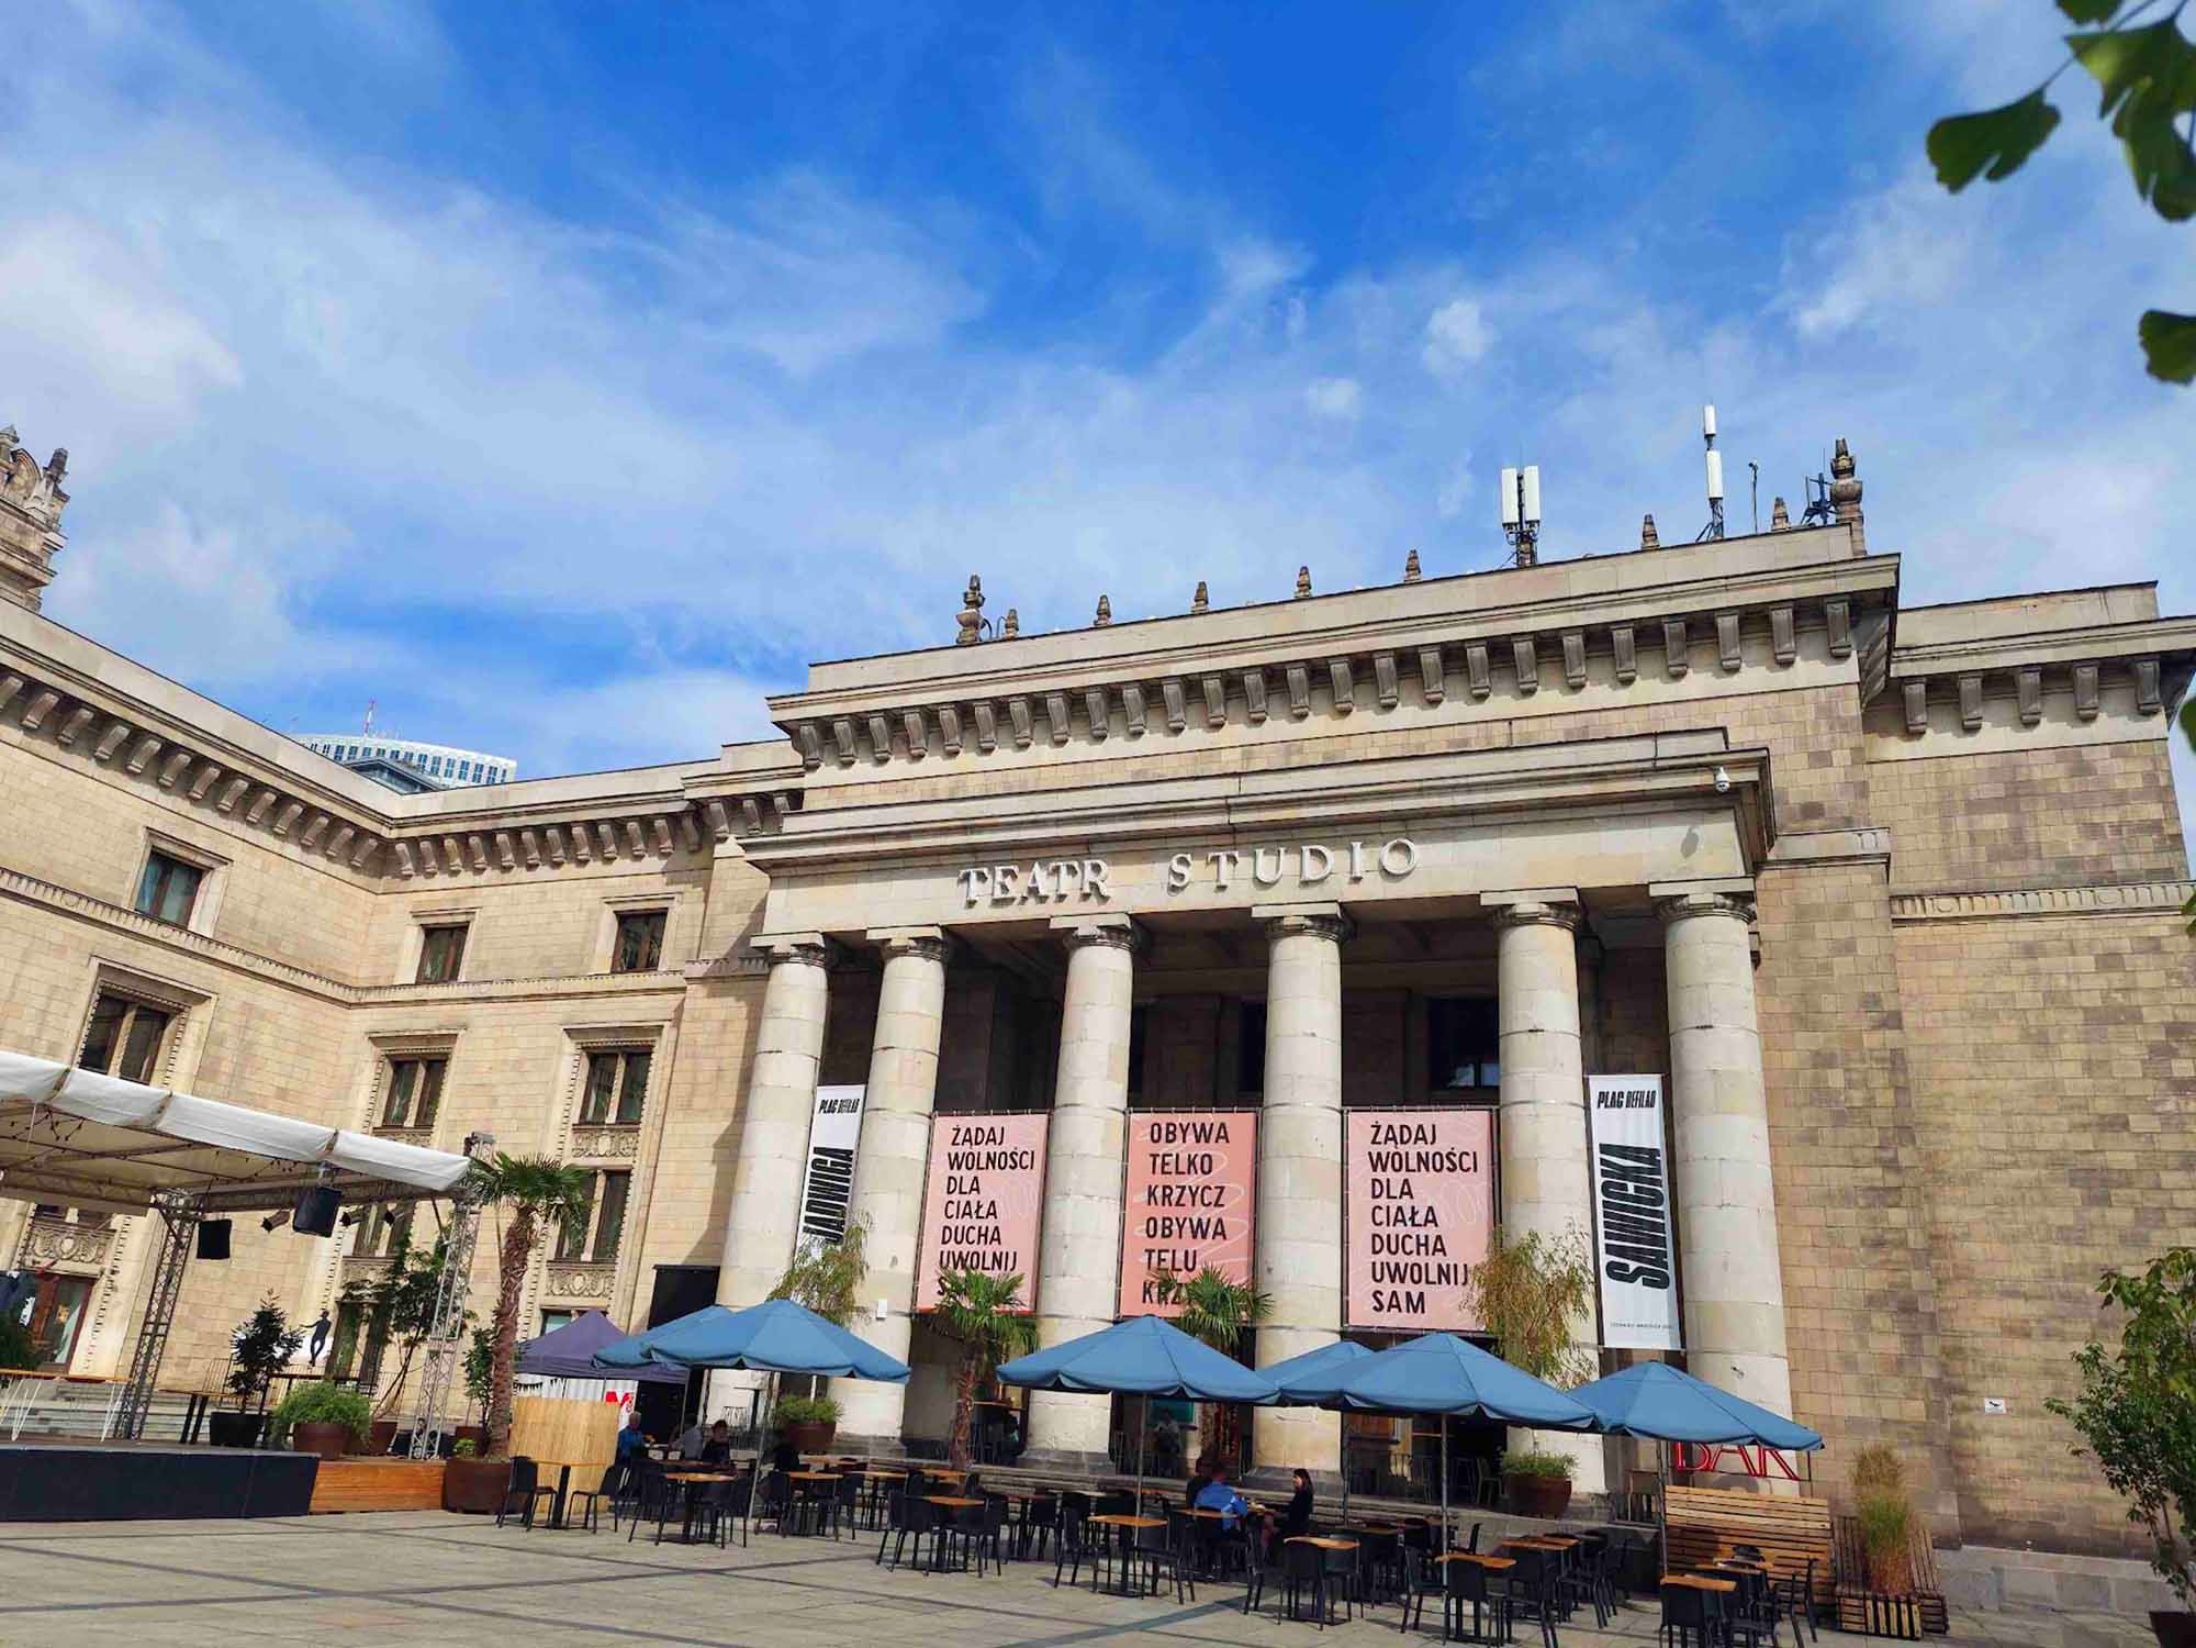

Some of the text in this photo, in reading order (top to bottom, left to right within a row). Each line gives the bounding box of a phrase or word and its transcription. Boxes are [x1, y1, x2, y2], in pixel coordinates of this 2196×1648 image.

[959, 838, 1418, 907] TEATR STUDIO
[818, 1099, 838, 1114] PLAC
[1597, 1090, 1657, 1109] PLAC DEFILAD
[951, 1125, 1005, 1149] ŻĄDAJ
[1150, 1122, 1230, 1144] OBYWA
[1370, 1121, 1437, 1149] ŻĄDAJ
[947, 1147, 1035, 1171] WOLNOŚCI
[1149, 1153, 1213, 1175] TELKO
[1368, 1147, 1478, 1173] WOLNOŚCI
[802, 1146, 854, 1246] JADWIGA
[946, 1175, 981, 1195] DLA
[1147, 1184, 1226, 1208] KRZYCZ
[1370, 1178, 1414, 1200] DLA
[944, 1200, 998, 1220] CIAŁA
[1371, 1205, 1439, 1228] CIAŁA
[1598, 1143, 1671, 1290] SAWICKA
[941, 1225, 1002, 1246] DUCHA
[1145, 1216, 1228, 1240] OBYWA
[1371, 1233, 1447, 1257] DUCHA
[939, 1251, 1018, 1272] UWOLNIJ
[1144, 1249, 1197, 1272] TELU
[1371, 1261, 1468, 1287] UWOLNIJ
[1372, 1290, 1426, 1315] SAM
